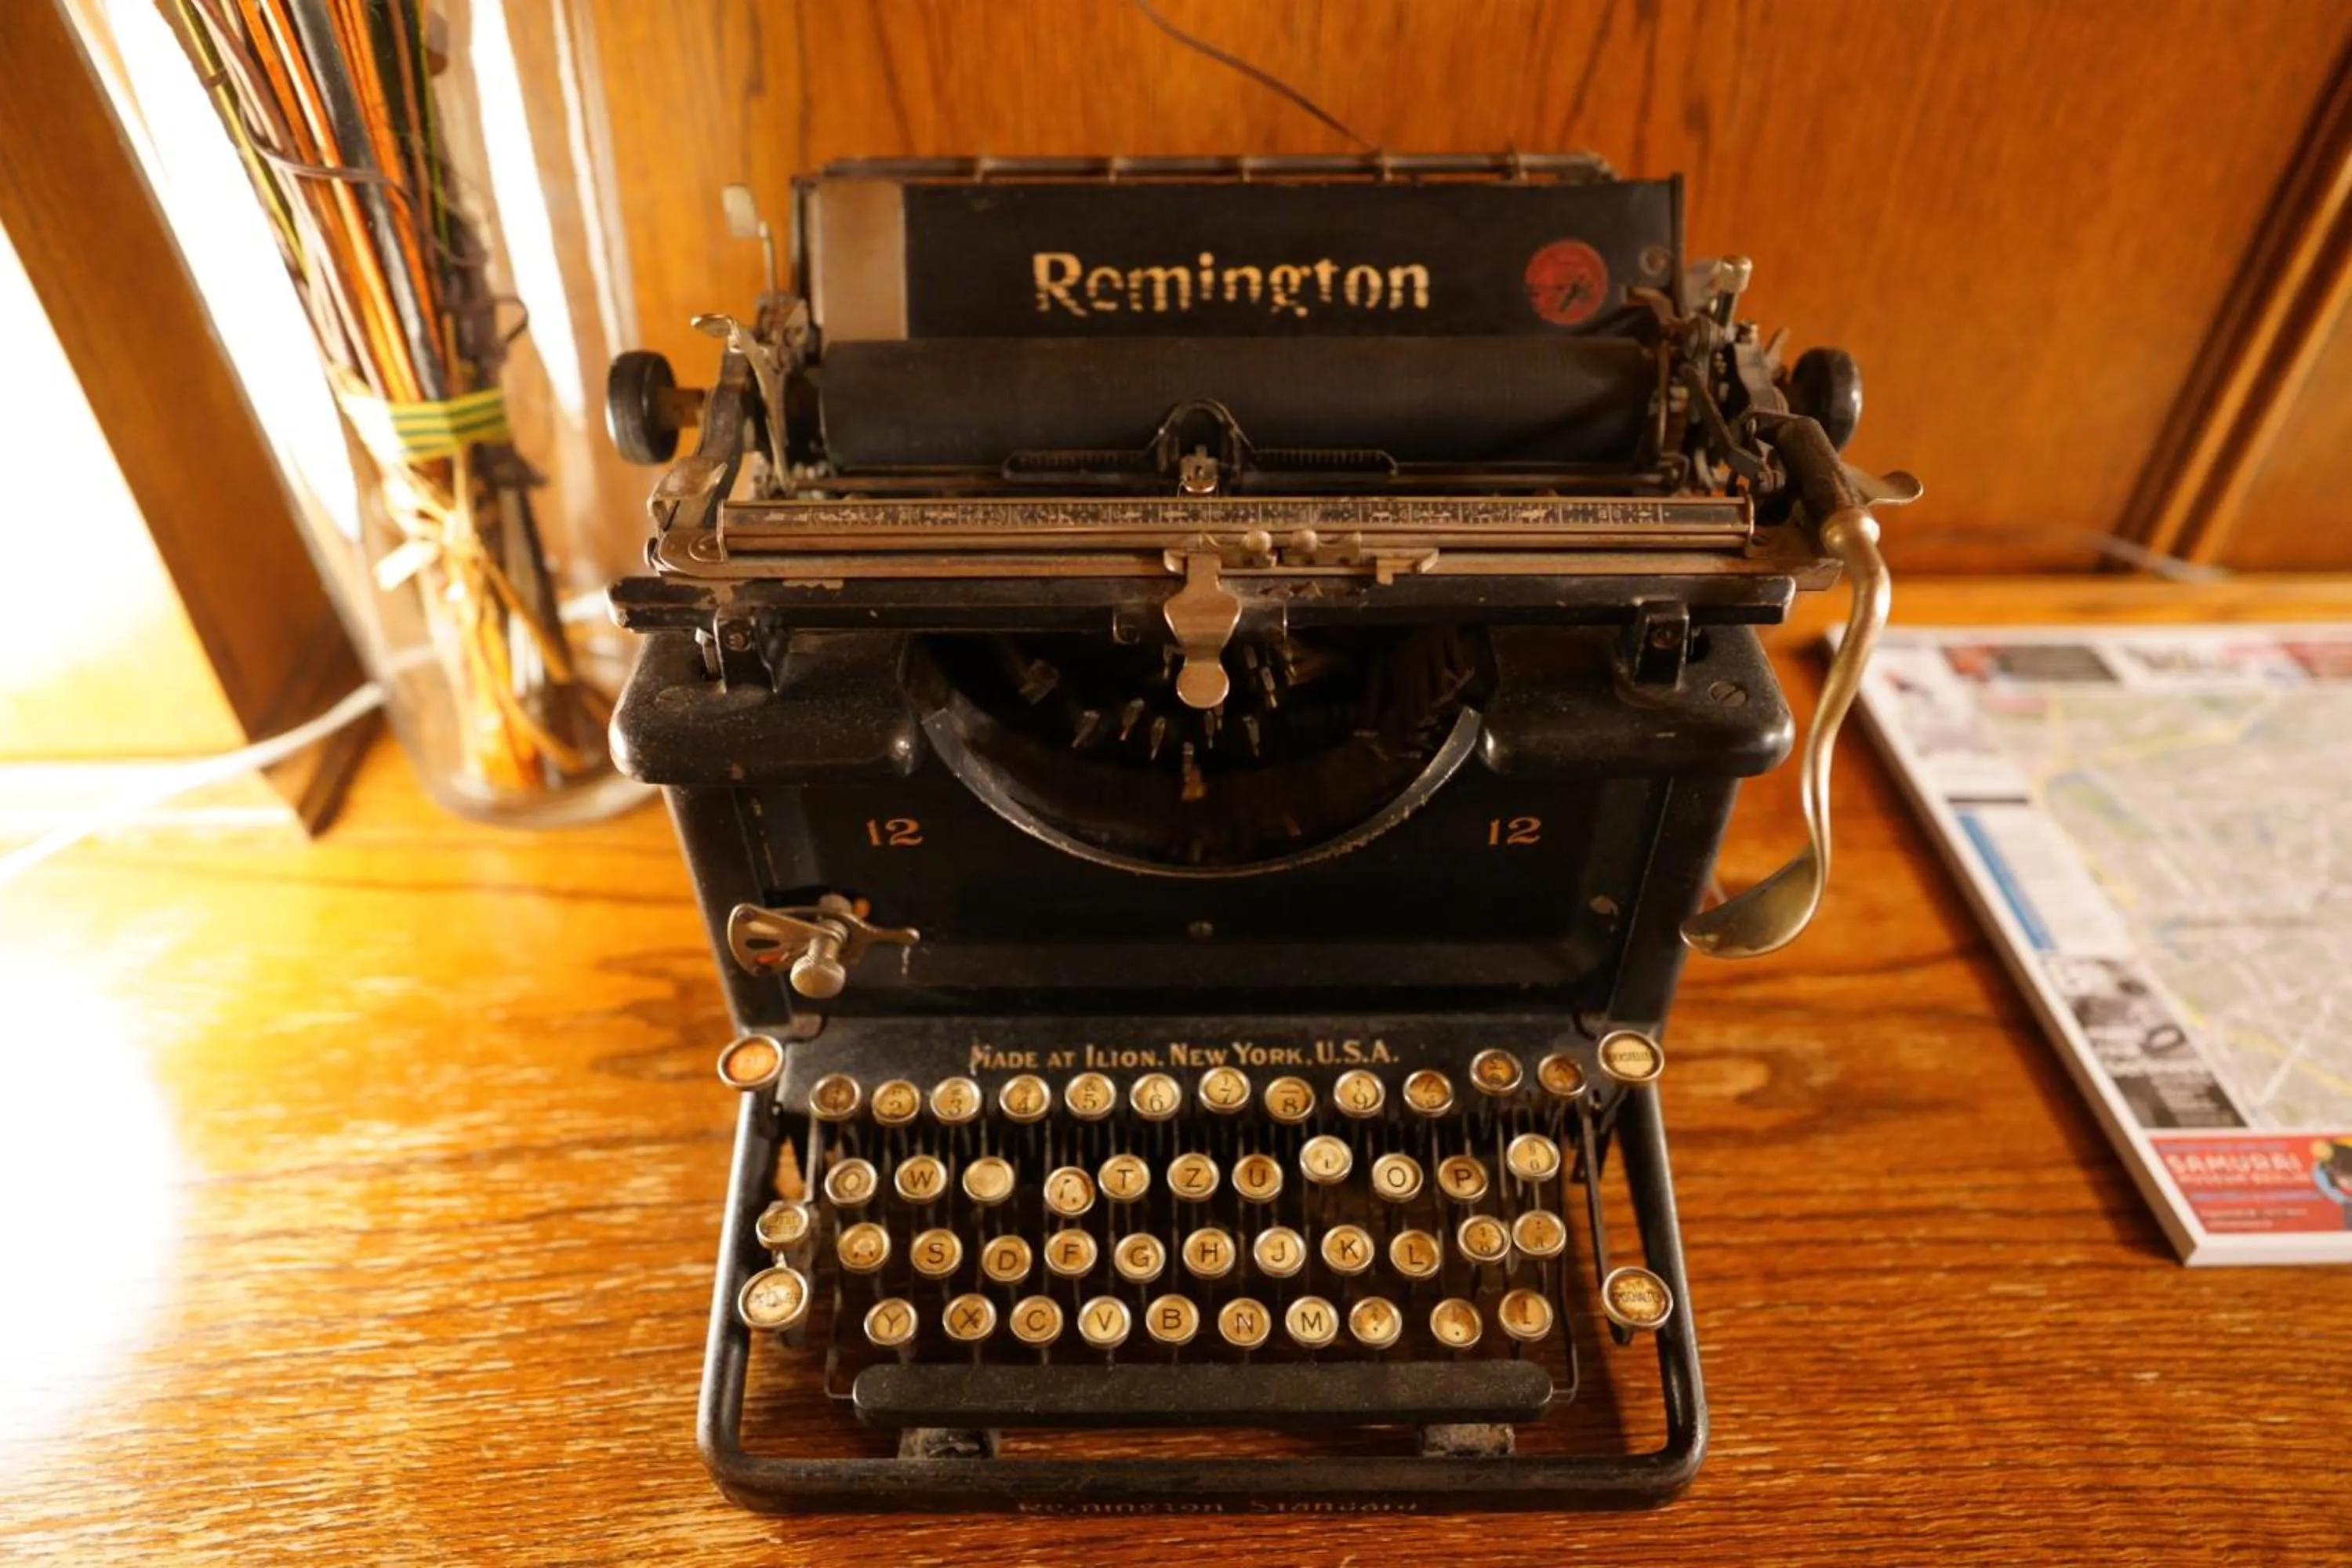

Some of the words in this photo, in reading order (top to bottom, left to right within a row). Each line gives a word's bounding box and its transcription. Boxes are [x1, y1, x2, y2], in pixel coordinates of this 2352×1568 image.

[1032, 251, 1430, 316] Remington
[866, 818, 924, 846] 12
[1488, 817, 1541, 845] 12
[1283, 1097, 1298, 1114] 8
[909, 1169, 935, 1190] W
[1116, 1168, 1134, 1189] T
[1185, 1167, 1203, 1188] Z
[1247, 1166, 1267, 1189] U
[1386, 1166, 1406, 1188] O
[1454, 1168, 1472, 1189] P
[926, 1242, 946, 1265] S
[997, 1249, 1018, 1271] D
[1062, 1243, 1080, 1265] F
[1130, 1245, 1150, 1268] G
[1200, 1240, 1219, 1263] H
[1271, 1241, 1286, 1263] J
[1339, 1239, 1360, 1261] K
[1408, 1243, 1425, 1265] L
[883, 1312, 902, 1333] Y
[960, 1308, 980, 1330] X
[1025, 1308, 1047, 1332] C
[1096, 1310, 1113, 1332] V
[1162, 1308, 1182, 1330] B
[1235, 1312, 1254, 1335] N
[1300, 1310, 1323, 1333] M
